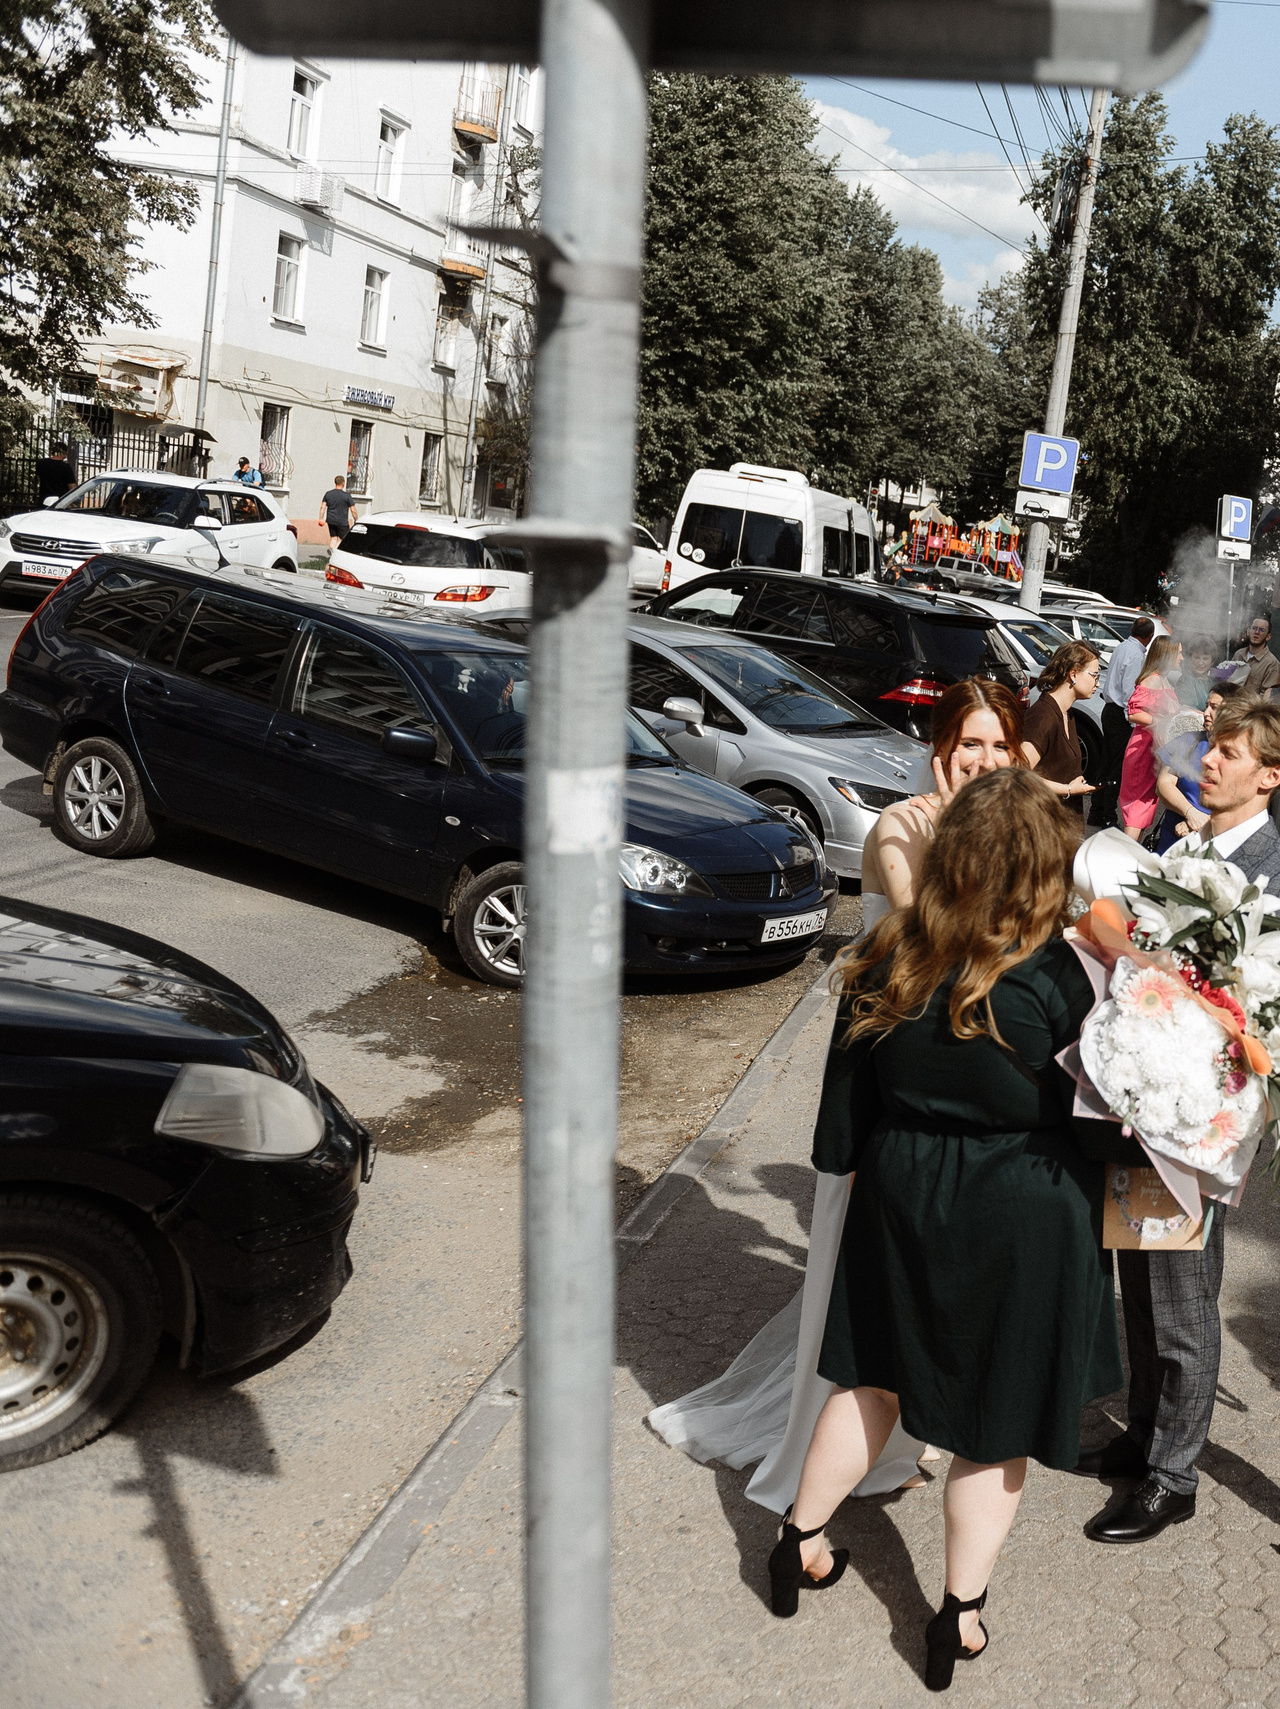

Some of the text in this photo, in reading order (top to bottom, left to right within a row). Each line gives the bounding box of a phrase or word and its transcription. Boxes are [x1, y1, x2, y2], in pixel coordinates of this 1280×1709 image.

[1035, 441, 1068, 483] P
[1230, 501, 1246, 533] P
[694, 551, 703, 559] 90
